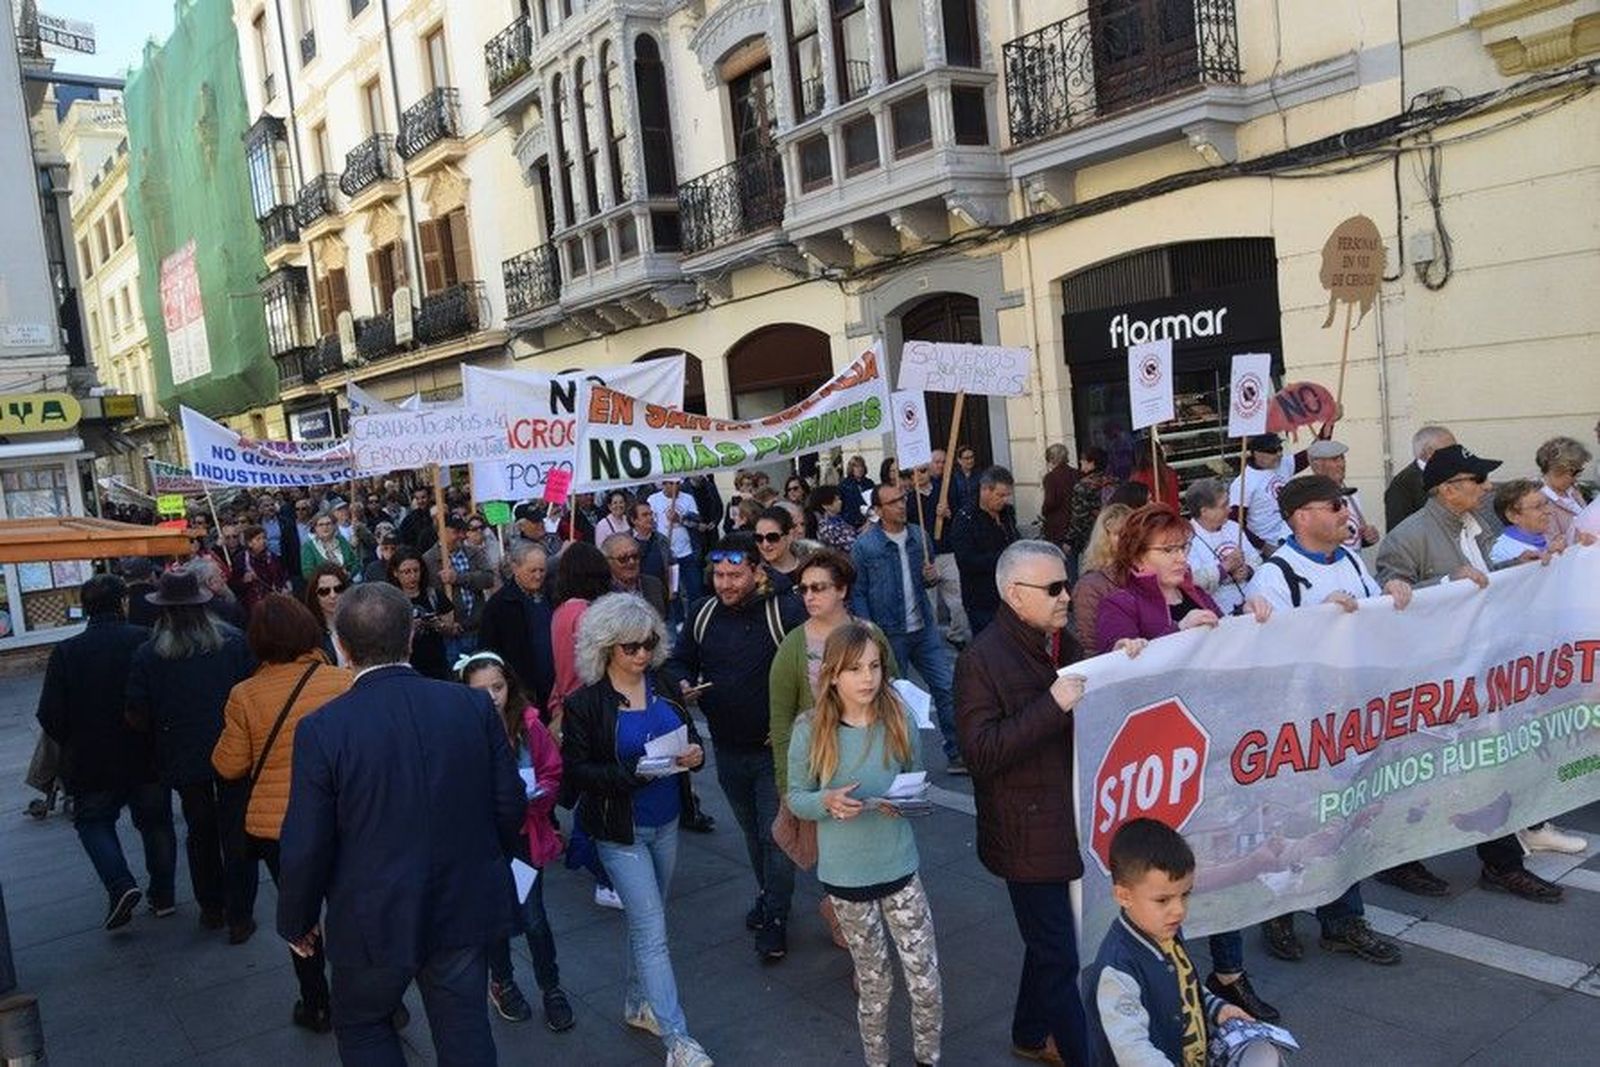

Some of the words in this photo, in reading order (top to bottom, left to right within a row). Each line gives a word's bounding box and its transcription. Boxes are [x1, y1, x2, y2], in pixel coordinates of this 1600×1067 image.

[1109, 307, 1228, 349] flormar
[0, 400, 68, 425] YA
[588, 384, 634, 426] EN
[1276, 385, 1323, 425] NO
[211, 445, 237, 463] NO
[589, 437, 652, 482] NO
[750, 396, 882, 462] PURINES
[194, 461, 326, 485] INDUSTRIALES
[1229, 675, 1481, 787] GANADERIA
[1486, 639, 1600, 714] INDUST
[1318, 782, 1369, 825] POR
[1370, 751, 1438, 800] UNOS
[1442, 720, 1544, 777] PUEBLOS
[1544, 702, 1600, 740] VIVOS
[1098, 746, 1199, 834] STOP
